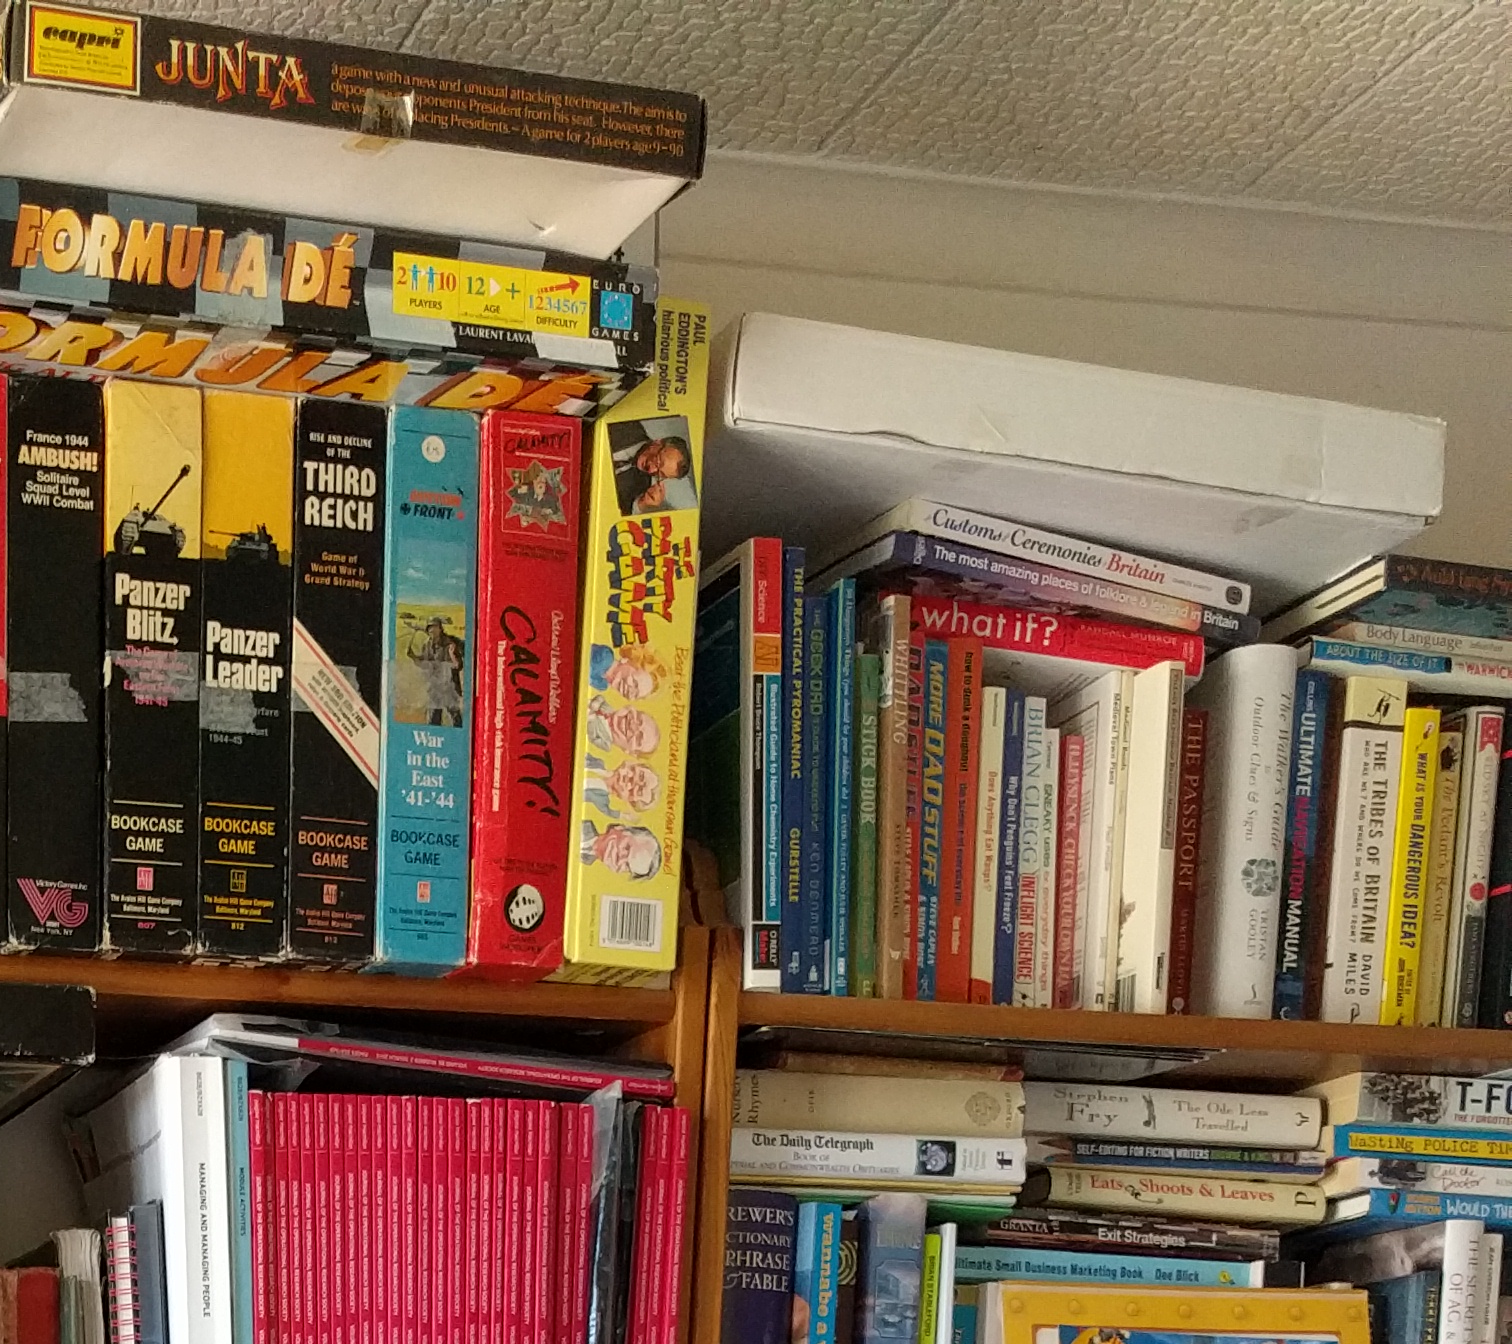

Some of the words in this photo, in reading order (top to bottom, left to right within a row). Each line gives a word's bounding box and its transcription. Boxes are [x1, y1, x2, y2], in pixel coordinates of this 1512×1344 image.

[156, 39, 313, 109] JUNTA
[12, 204, 269, 299] FORMULA
[284, 234, 357, 308] DÉ
[410, 298, 443, 312] PLAYERS
[535, 316, 579, 329] DIFFICULTY
[18, 444, 98, 472] AMBUSH!
[304, 461, 376, 496] THIRD
[304, 496, 374, 531] REICH
[115, 573, 191, 610] Panzer
[206, 622, 280, 660] Panzer
[922, 604, 1004, 638] what
[1013, 615, 1060, 646] if?
[205, 654, 283, 692] Leader
[1371, 741, 1389, 772] THE
[1368, 774, 1387, 838] TRIBES
[111, 814, 184, 834] BOOKCASE
[126, 835, 165, 853] GAME
[1366, 842, 1381, 862] OF
[1359, 871, 1380, 944] BRITAIN
[751, 1133, 775, 1150] The
[778, 1134, 810, 1153] Daily
[813, 1135, 874, 1154] Telegraph
[198, 1162, 208, 1215] MANAGING
[1138, 1178, 1192, 1197] Shoots
[1199, 1183, 1214, 1198] &
[1220, 1184, 1275, 1203] Leaves
[200, 1216, 209, 1232] AND
[200, 1233, 210, 1283] MANAGING
[202, 1284, 212, 1318] PEOPLE
